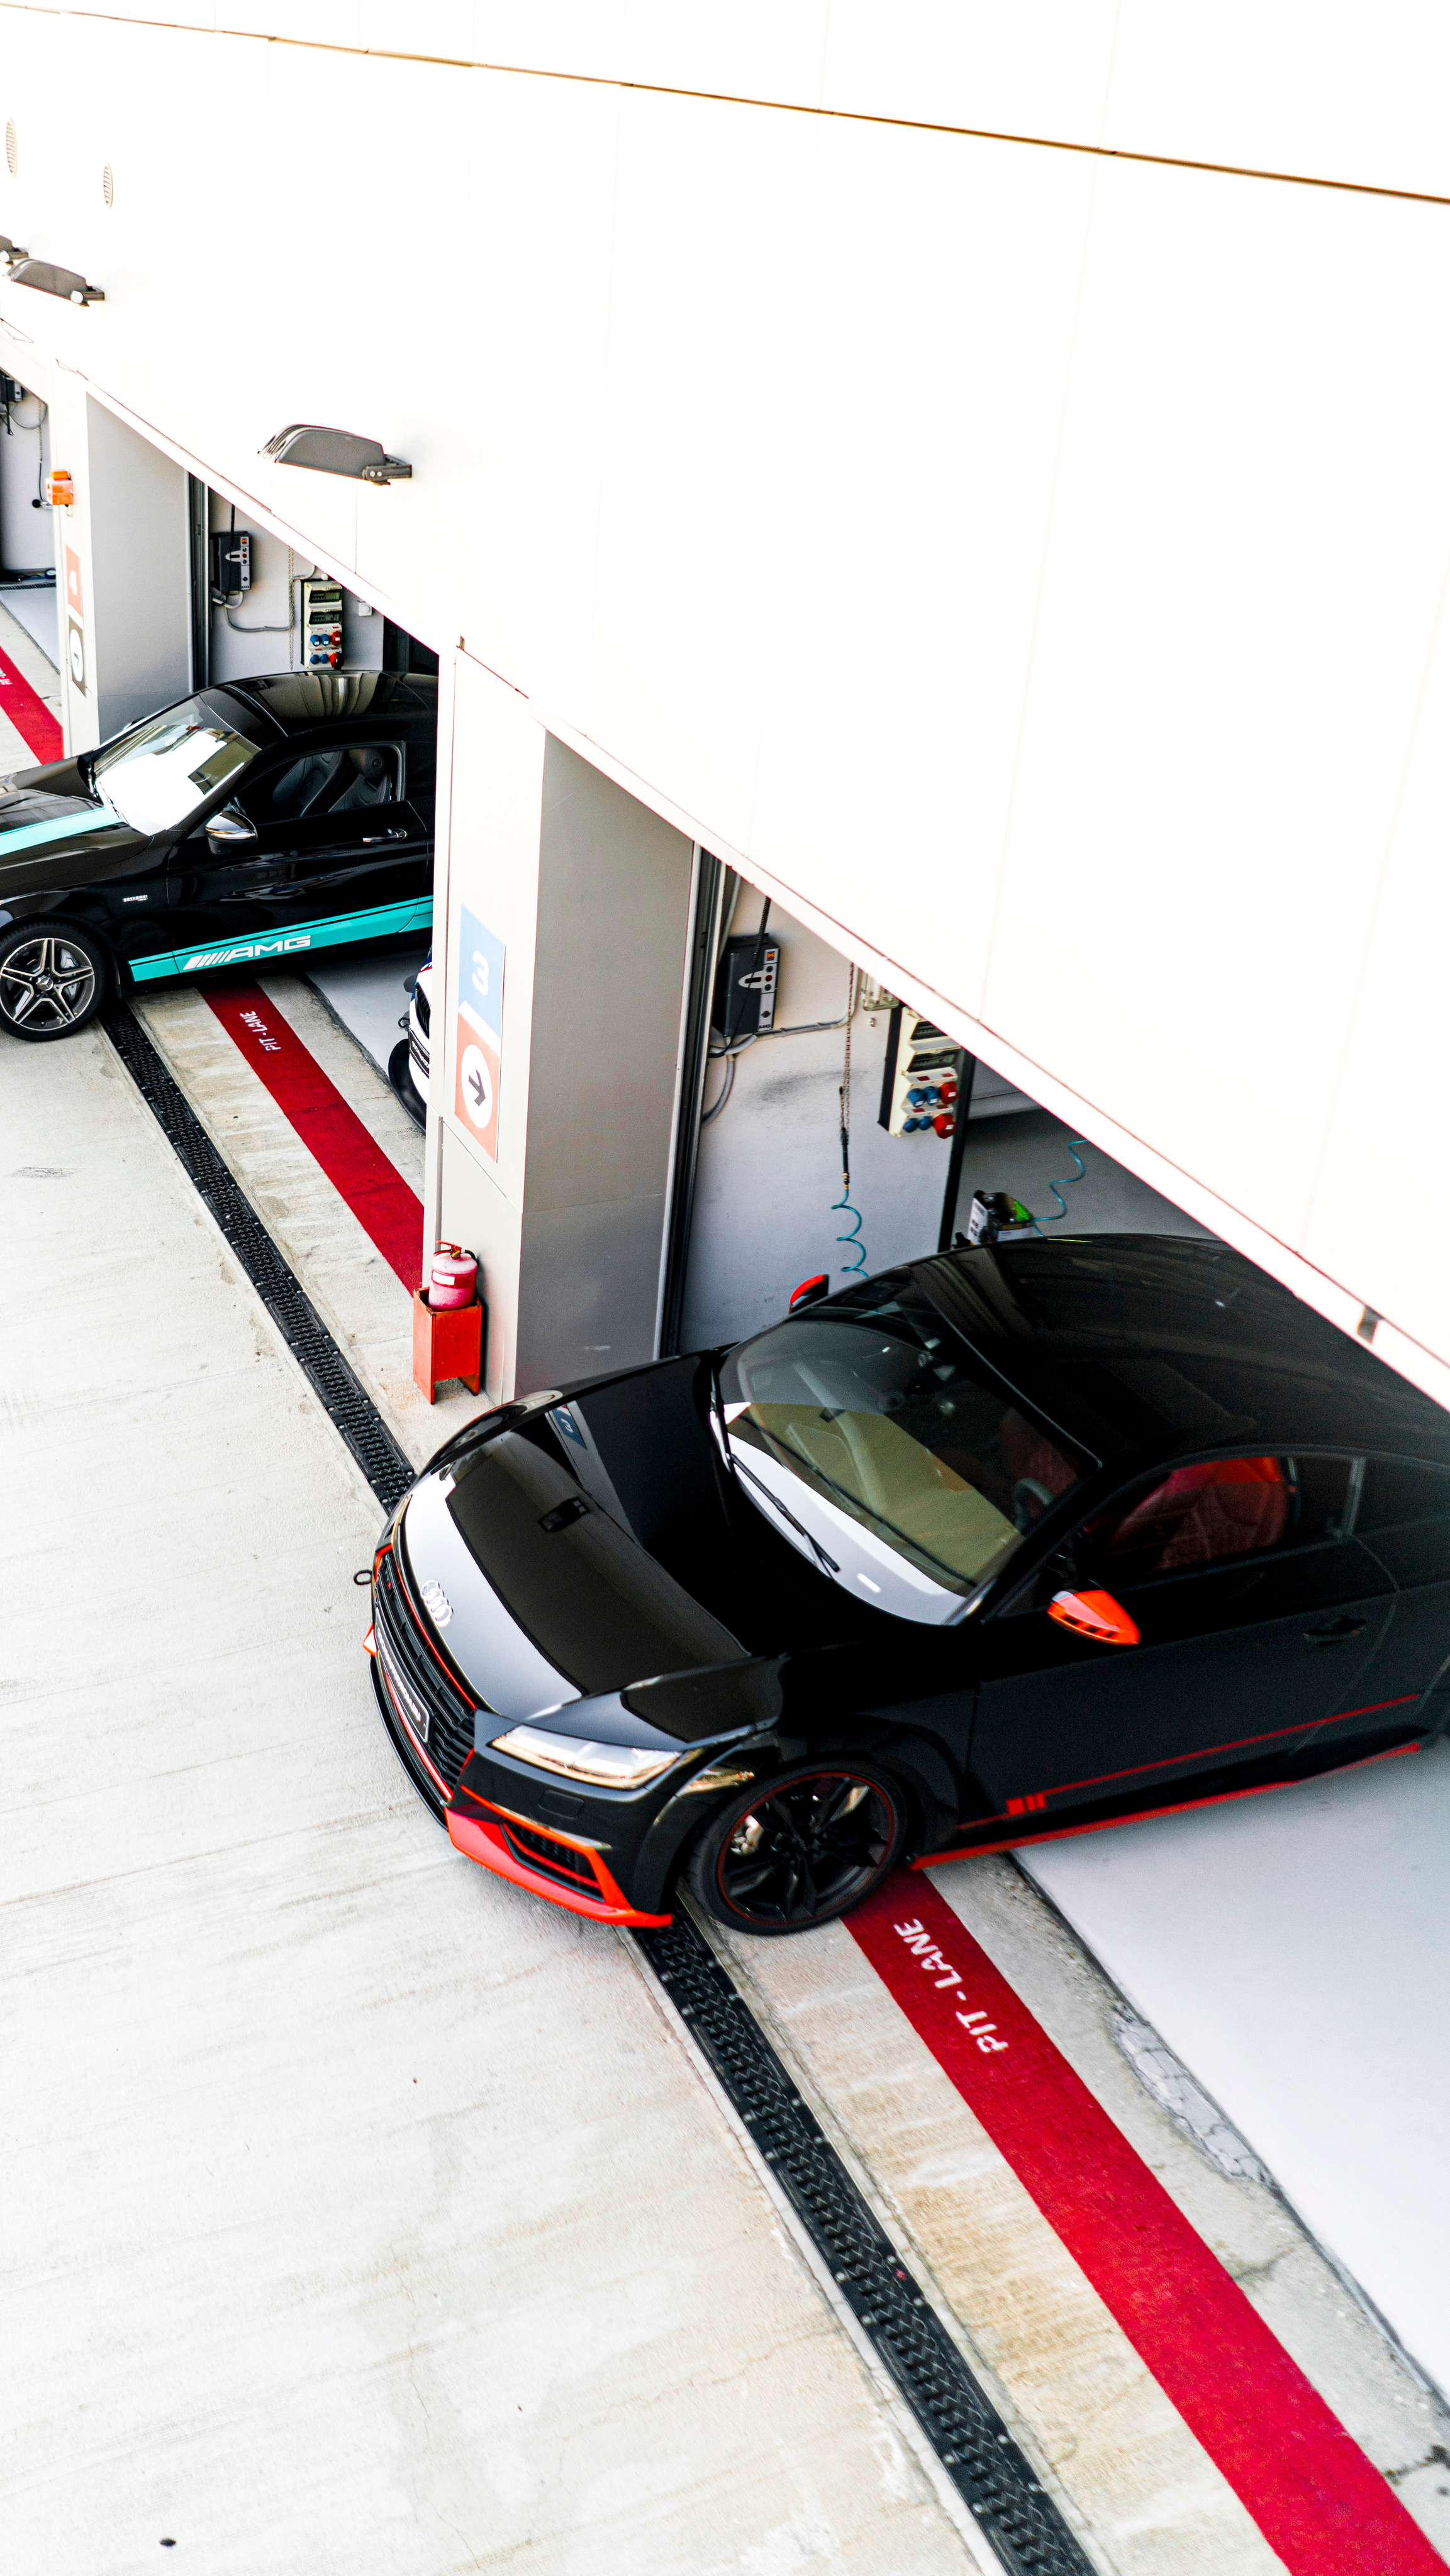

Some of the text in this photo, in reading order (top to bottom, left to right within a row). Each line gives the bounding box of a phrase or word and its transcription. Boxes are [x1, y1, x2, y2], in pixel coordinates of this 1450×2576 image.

[223, 935, 311, 963] AMG
[472, 950, 489, 996] 3
[240, 1011, 267, 1032] LANE
[259, 1038, 281, 1051] PIT
[893, 1918, 962, 1989] LANE
[955, 2011, 1009, 2053] PIT
